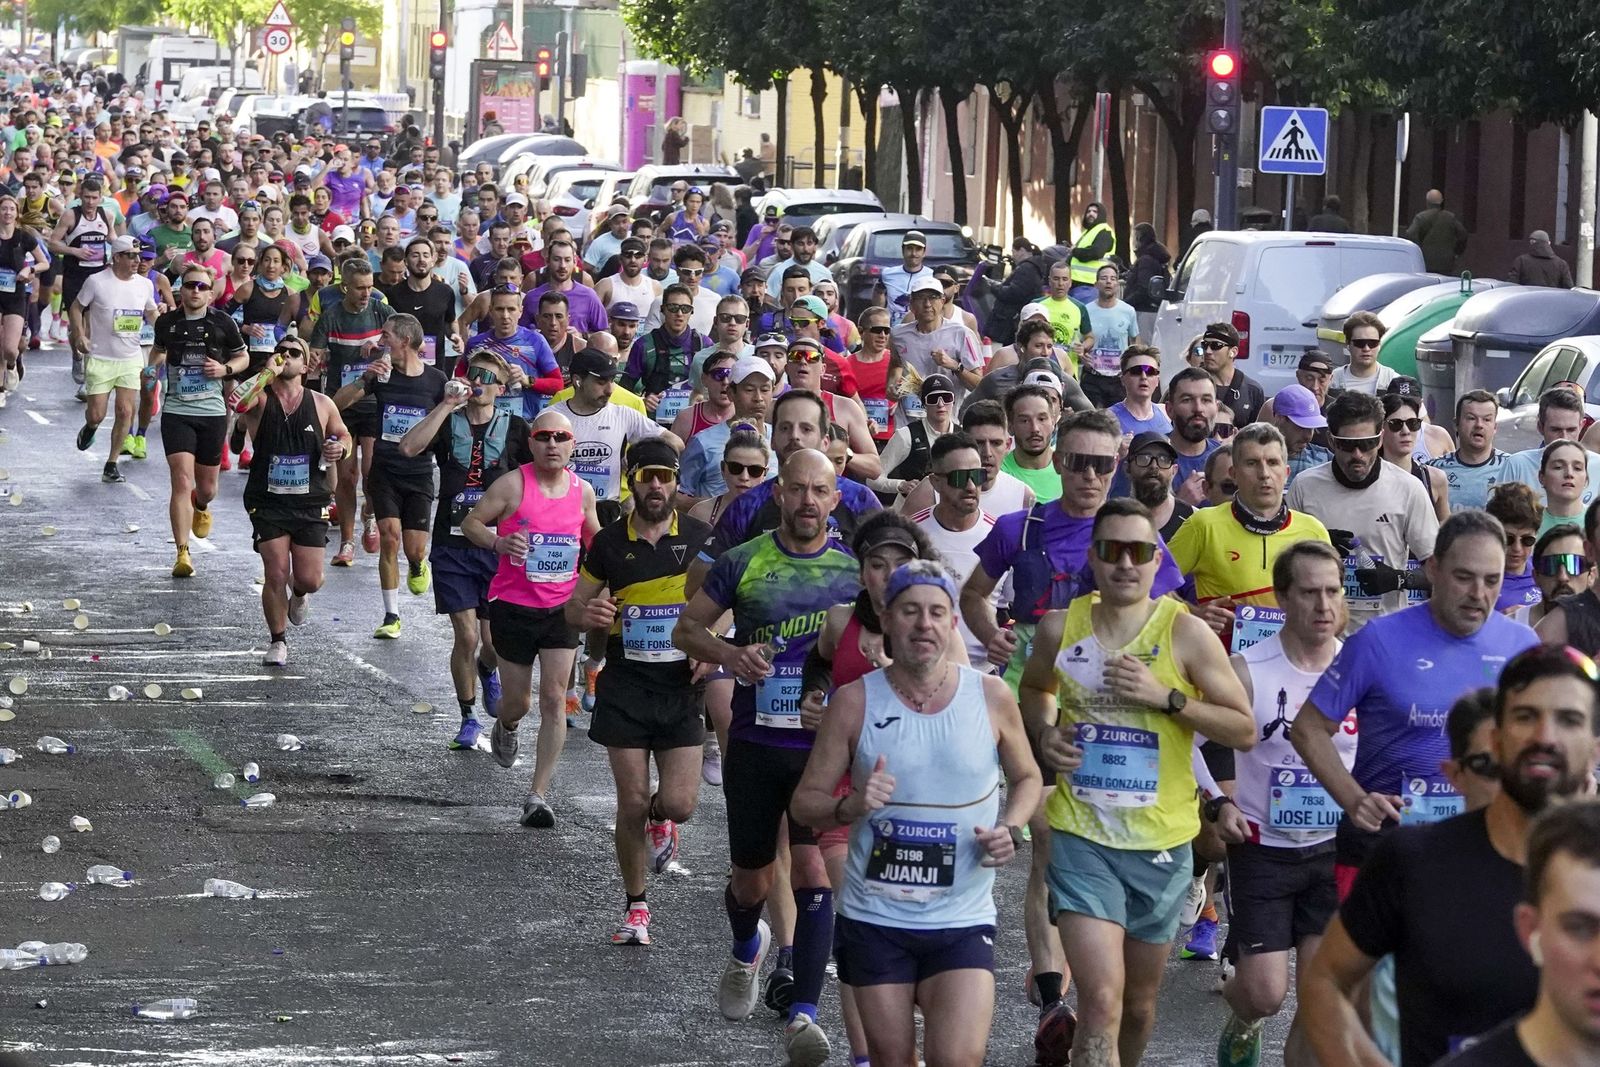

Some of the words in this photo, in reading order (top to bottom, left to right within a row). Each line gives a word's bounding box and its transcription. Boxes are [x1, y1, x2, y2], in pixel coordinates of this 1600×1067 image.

[271, 36, 287, 45] 30
[1270, 355, 1297, 365] 9177
[181, 384, 209, 393] MICHIEL
[398, 407, 421, 416] ZURICH
[390, 425, 410, 434] CÉSA
[282, 457, 305, 465] ZURICH
[578, 465, 605, 473] ZURICH
[547, 536, 573, 544] ZURICH
[537, 560, 569, 571] OSCAR
[644, 607, 680, 617] ZURICH
[1258, 610, 1287, 620] ZURIC
[645, 625, 665, 634] 7488
[624, 639, 645, 649] JOSÉ
[647, 640, 676, 649] FONS
[780, 666, 803, 675] ZUR
[781, 685, 802, 695] 8272
[1407, 702, 1450, 737] Atmósf
[1101, 729, 1152, 744] ZURICH
[1101, 753, 1127, 766] 8882
[1072, 772, 1102, 786] RUBÉN
[1105, 776, 1158, 790] GONZÁLEZ
[1301, 795, 1325, 806] 7838
[1432, 805, 1458, 816] 7018
[1273, 809, 1313, 826] JOSE
[1317, 810, 1344, 826] LUI
[896, 825, 947, 839] ZURICH
[895, 848, 924, 862] 5198
[879, 863, 939, 884] JUANJI
